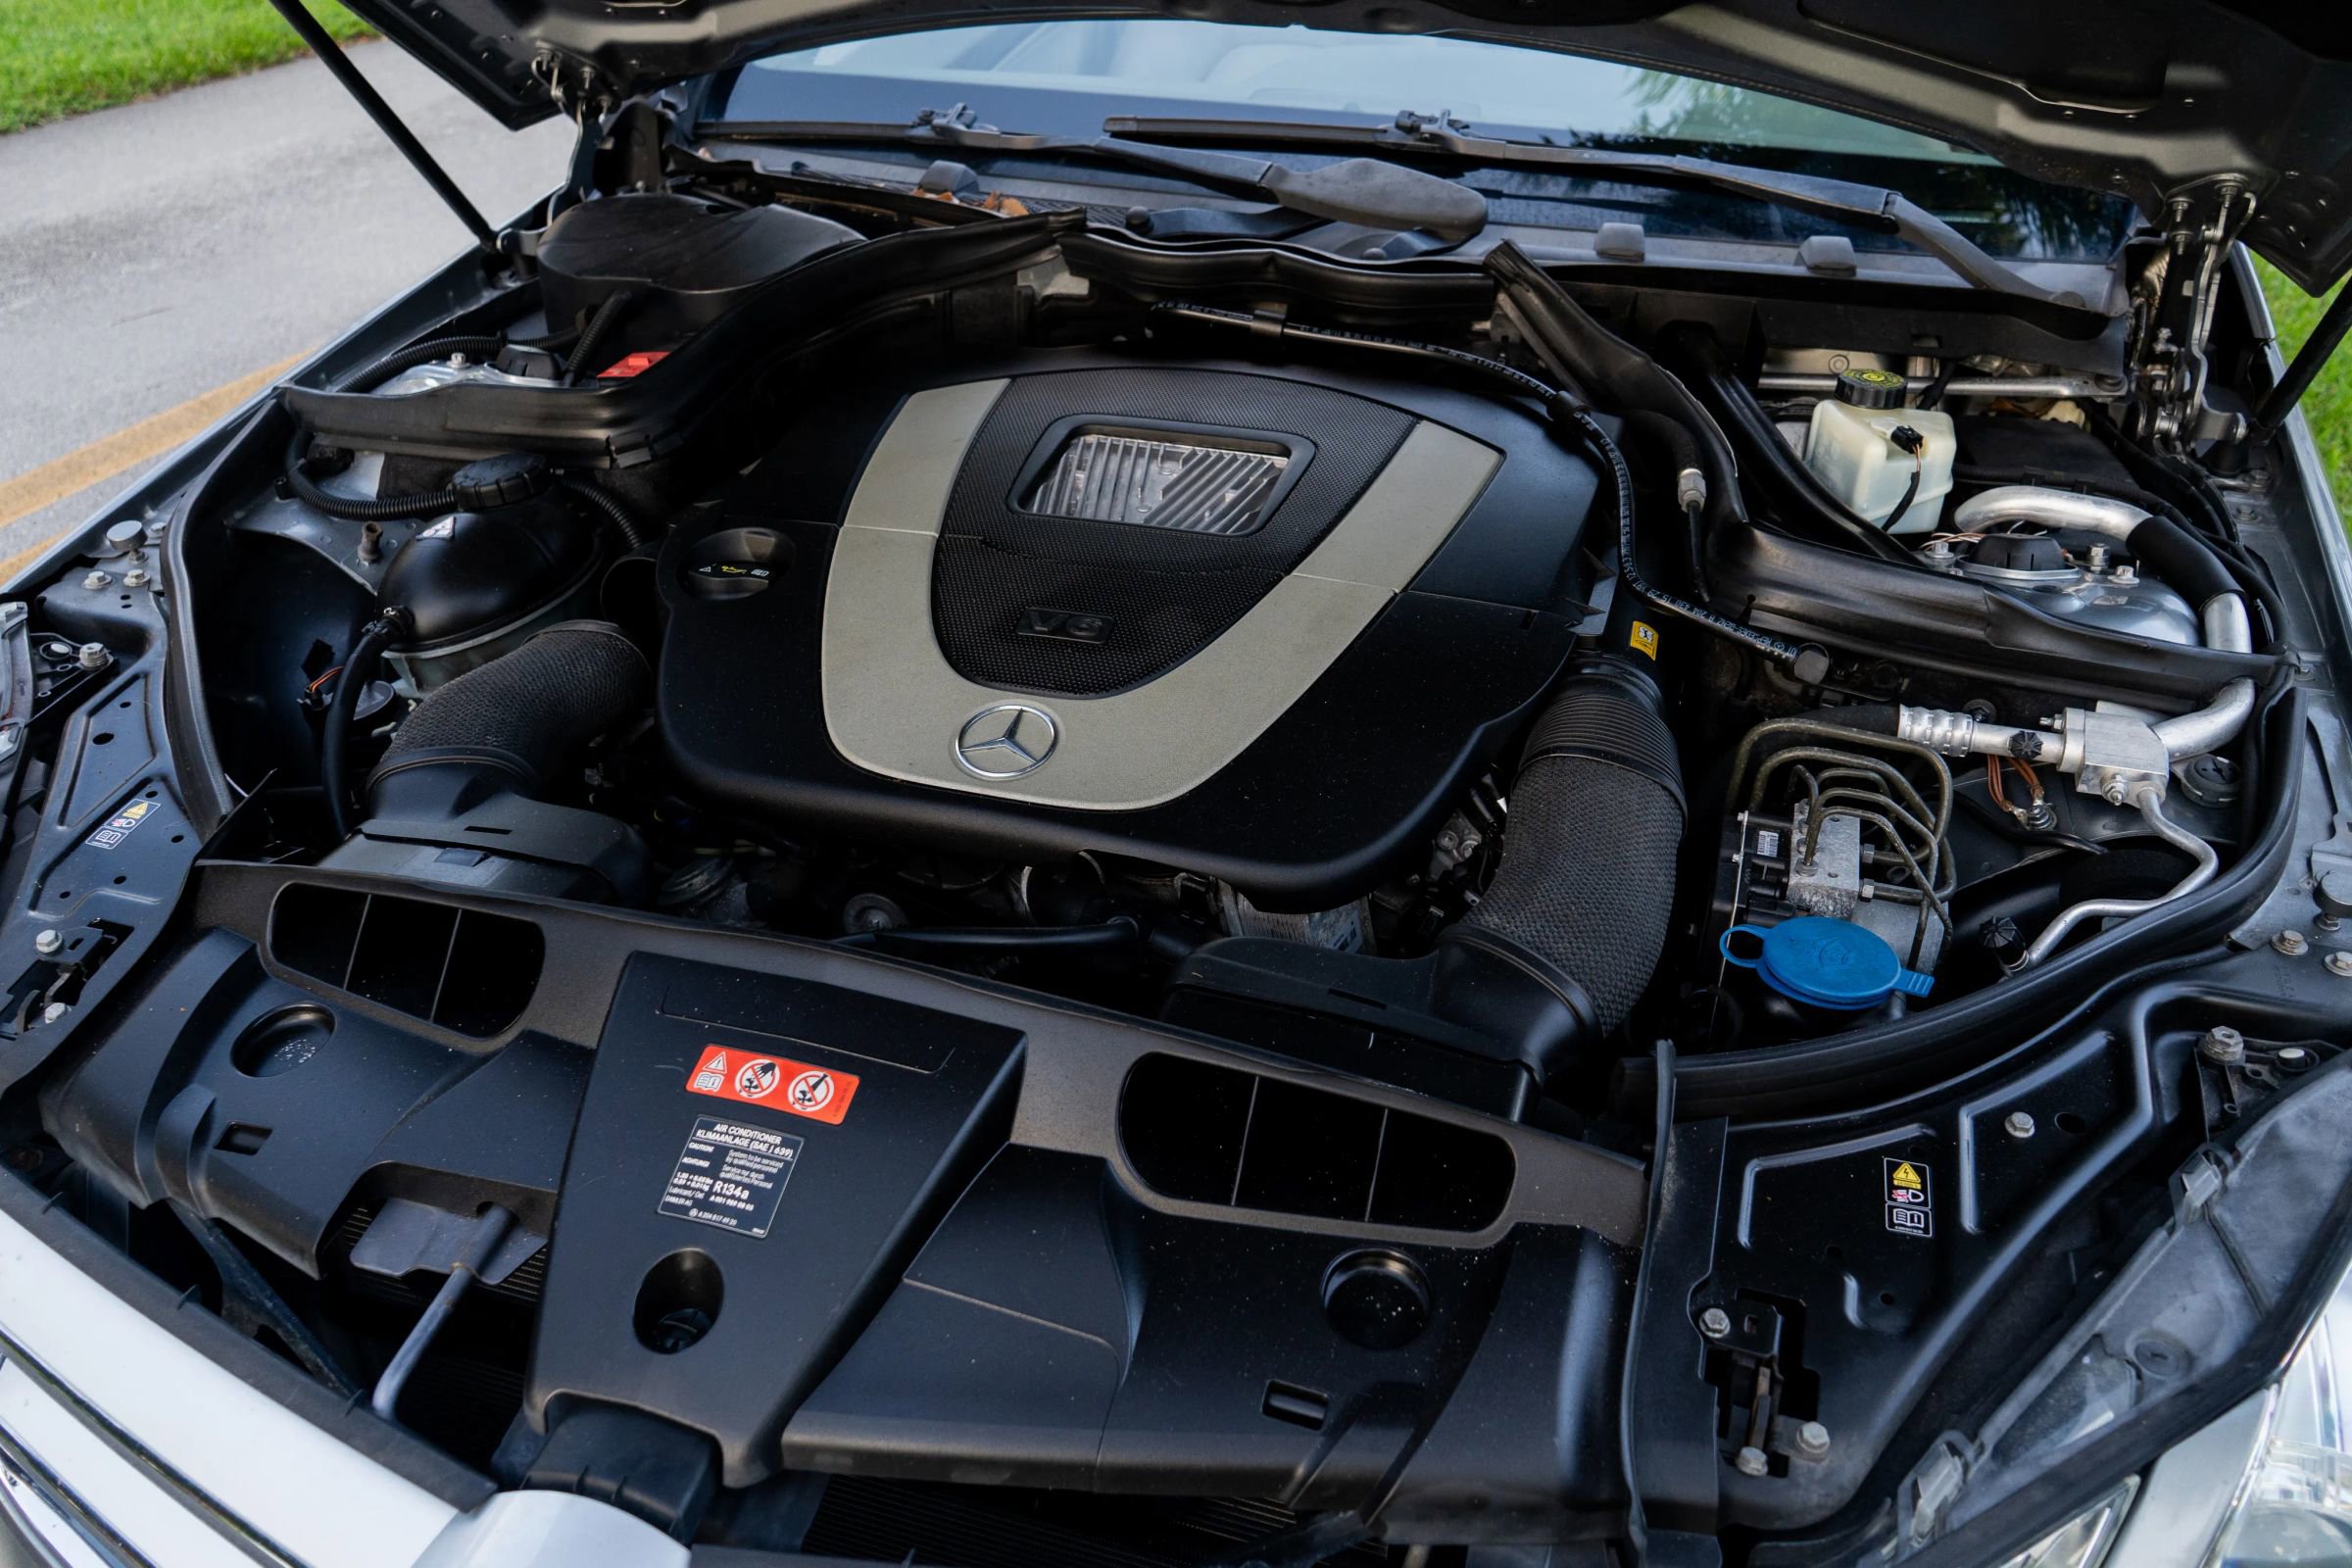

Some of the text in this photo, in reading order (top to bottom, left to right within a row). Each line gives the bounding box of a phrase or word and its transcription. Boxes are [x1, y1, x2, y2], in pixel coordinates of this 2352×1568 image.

[696, 1129, 751, 1147] KLIMAANLAGE
[748, 1141, 769, 1152] (SAE
[772, 1147, 793, 1158] 639)
[713, 1123, 782, 1145] AIR CONDITIONER
[712, 1181, 750, 1200] R134a
